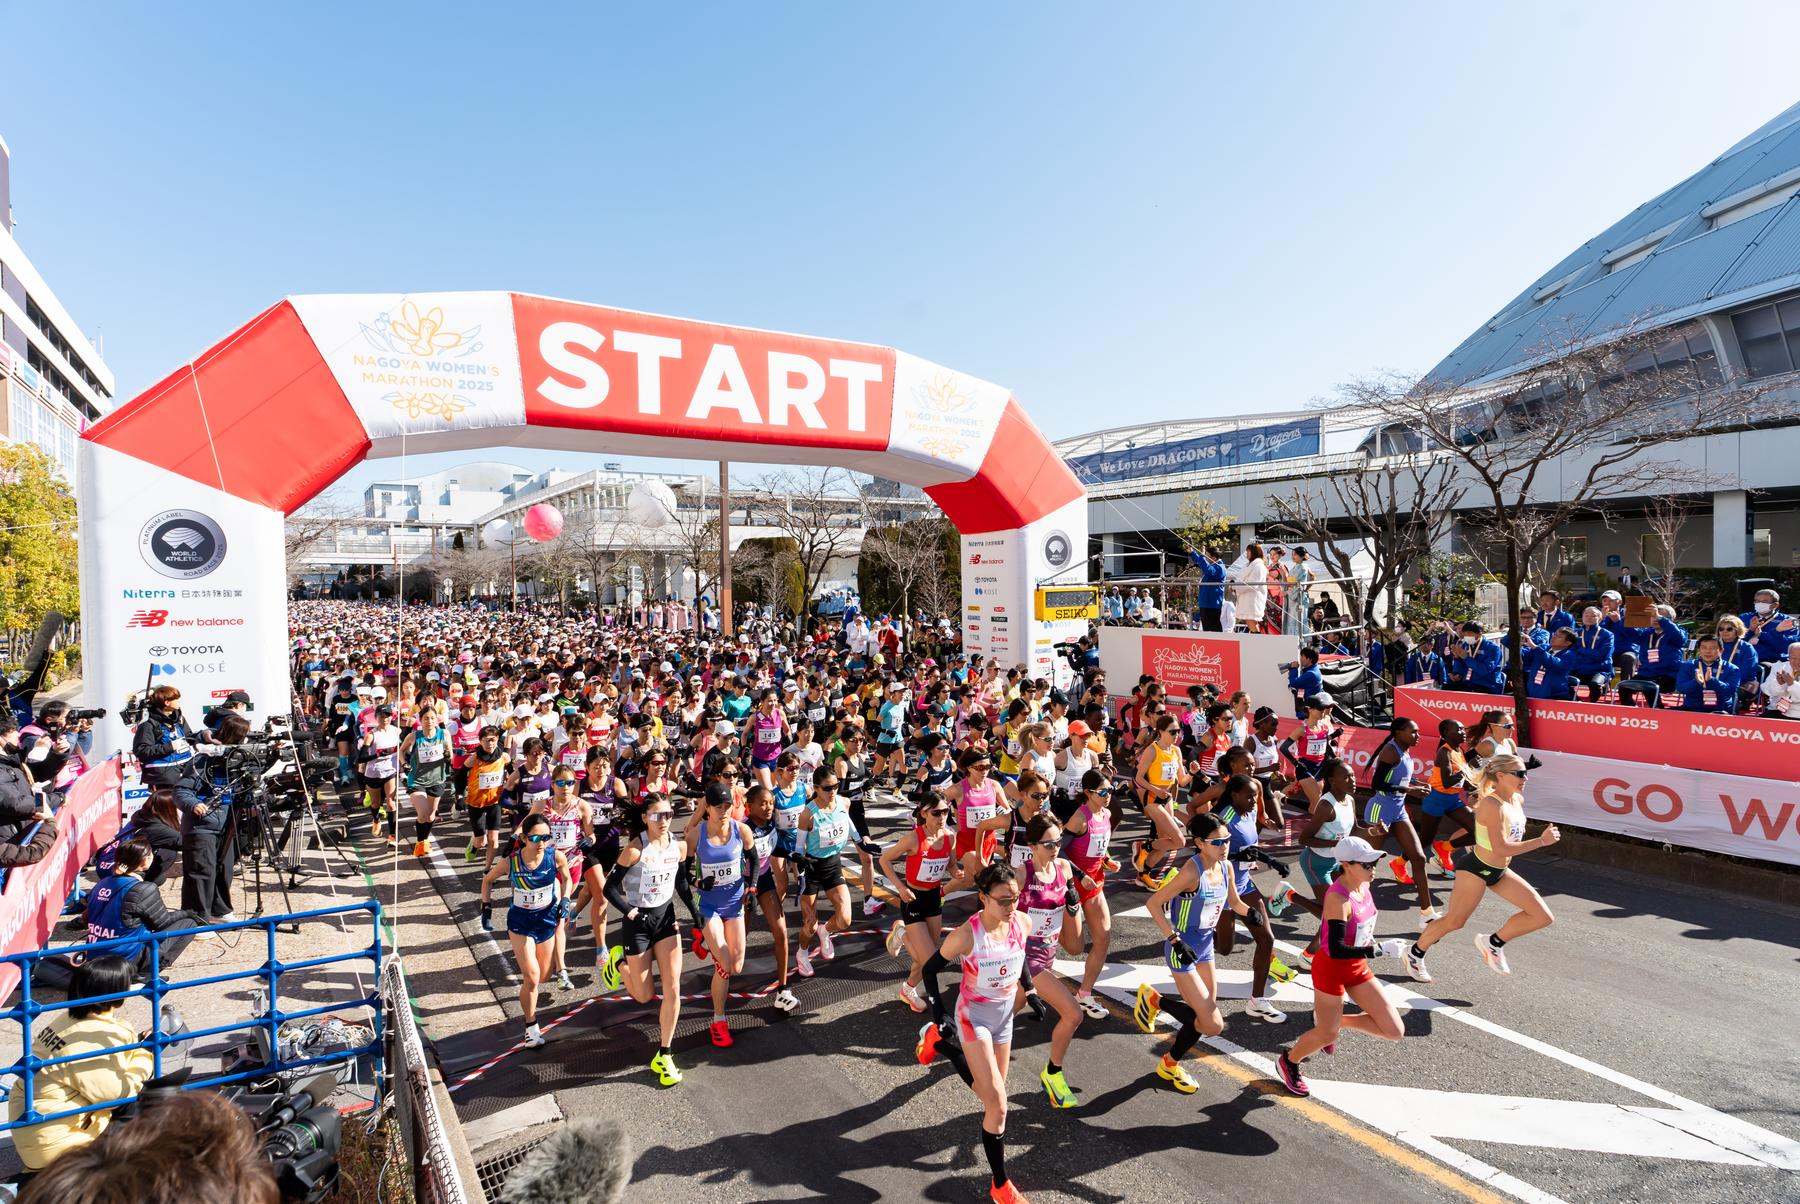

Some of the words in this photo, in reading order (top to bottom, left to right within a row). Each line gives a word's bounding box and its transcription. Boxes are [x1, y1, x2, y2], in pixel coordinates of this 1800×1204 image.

[353, 354, 421, 370] NAGOYA
[426, 360, 500, 377] WOMEN'S
[362, 372, 453, 388] MARATHON
[458, 379, 494, 391] 2025
[536, 320, 883, 433] START
[960, 429, 981, 438] 2025
[1249, 427, 1301, 457] Dragons
[1099, 461, 1116, 474] We
[1117, 459, 1145, 473] Love
[1147, 444, 1217, 468] DRAGONS
[183, 569, 203, 577] ROAD
[123, 589, 176, 599] Niterra
[1055, 608, 1088, 619] SEIKO
[170, 619, 194, 627] new
[197, 618, 244, 627] balance
[171, 645, 224, 655] TOYOTA
[182, 660, 226, 674] KOSÉ
[1189, 666, 1217, 674] WOMEN'S
[1166, 672, 1199, 681] MARATHON
[1419, 698, 1468, 712] NAGOYA
[1471, 703, 1532, 718] WOMENS
[1536, 709, 1618, 727] MARATHON
[1620, 716, 1659, 730] 2025
[1690, 724, 1765, 742] NAGOYA
[485, 775, 500, 783] 149
[1593, 777, 1684, 823] GO
[974, 811, 991, 820] 125
[1718, 793, 1800, 841] W
[827, 826, 844, 838] 105
[1021, 851, 1034, 860] 10
[711, 867, 732, 878] 108
[928, 864, 944, 873] 104
[651, 872, 670, 883] 112
[98, 887, 112, 898] GO
[523, 892, 543, 902] 113
[0, 886, 37, 948] AGOYA
[1045, 917, 1052, 927] 5
[979, 960, 1002, 968] Niterra
[999, 965, 1007, 976] 6
[37, 1026, 67, 1053] STAFF
